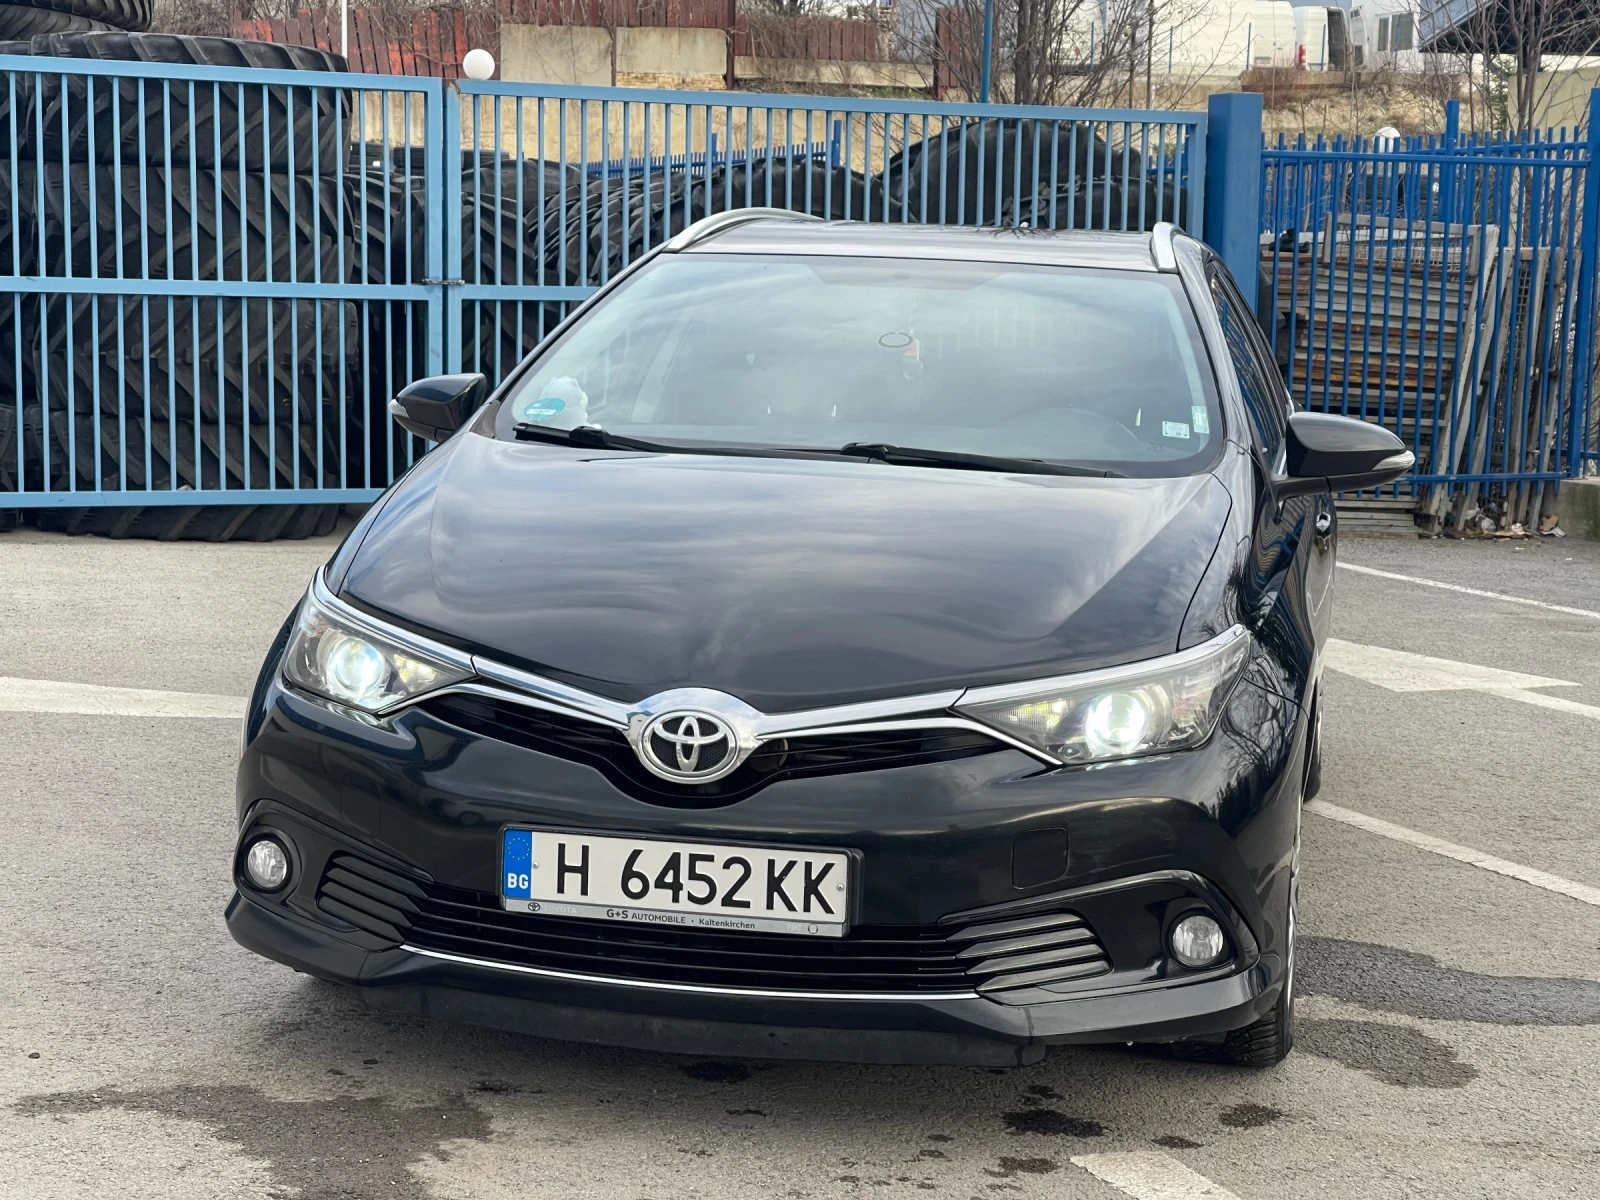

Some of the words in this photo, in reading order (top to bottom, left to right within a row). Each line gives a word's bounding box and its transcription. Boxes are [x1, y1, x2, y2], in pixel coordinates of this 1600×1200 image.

[507, 872, 529, 889] BG
[557, 843, 590, 896] H
[621, 849, 752, 908] 6452
[766, 858, 835, 914] KK
[606, 908, 629, 919] G+S
[631, 913, 686, 924] AUTOMOBILE
[698, 918, 756, 929] Kaltenkirchen
